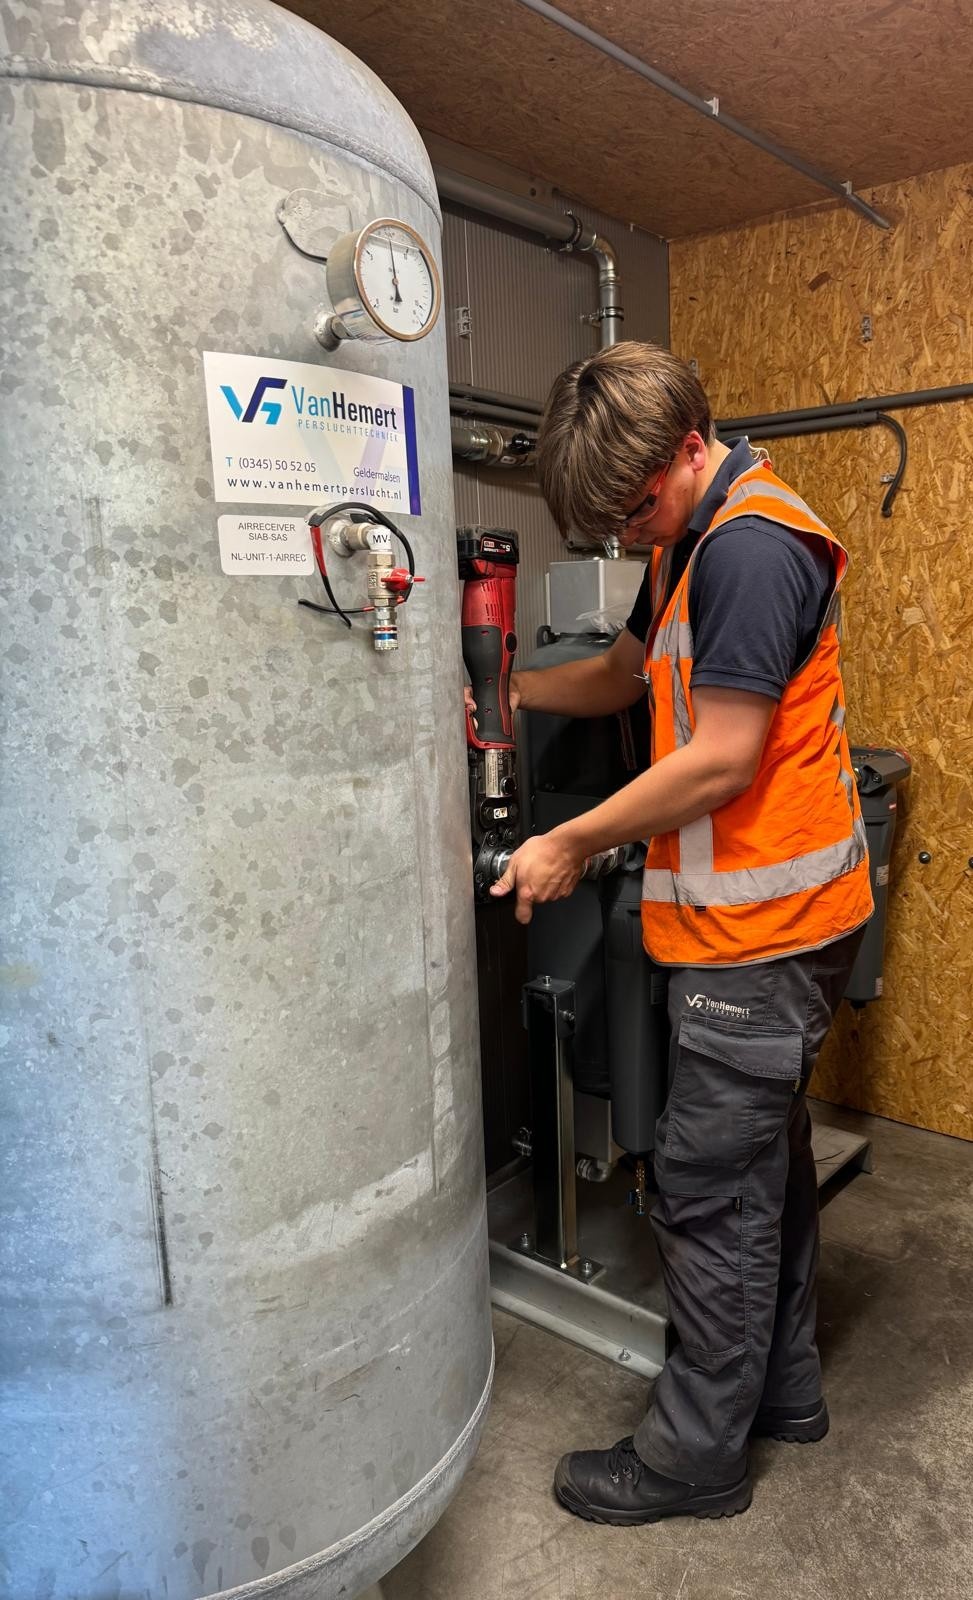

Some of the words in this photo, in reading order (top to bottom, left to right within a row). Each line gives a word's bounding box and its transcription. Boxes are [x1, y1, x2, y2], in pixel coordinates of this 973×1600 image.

[291, 385, 397, 430] VanHemert
[297, 418, 398, 442] PERSLUCHTTECHNIEK
[225, 456, 233, 467] T
[238, 457, 273, 471] (0345)
[275, 459, 288, 471] 50
[290, 461, 302, 472] 52
[304, 462, 316, 472] 05
[353, 466, 401, 483] Geldermalsen
[227, 477, 402, 500] www.vanhemertperslucht.nl
[238, 522, 296, 532] AIRRECEIVER
[248, 532, 288, 542] SIAB-SAS
[231, 552, 307, 563] NL-UNIT-1-AIRREC
[705, 998, 751, 1015] VanHemert
